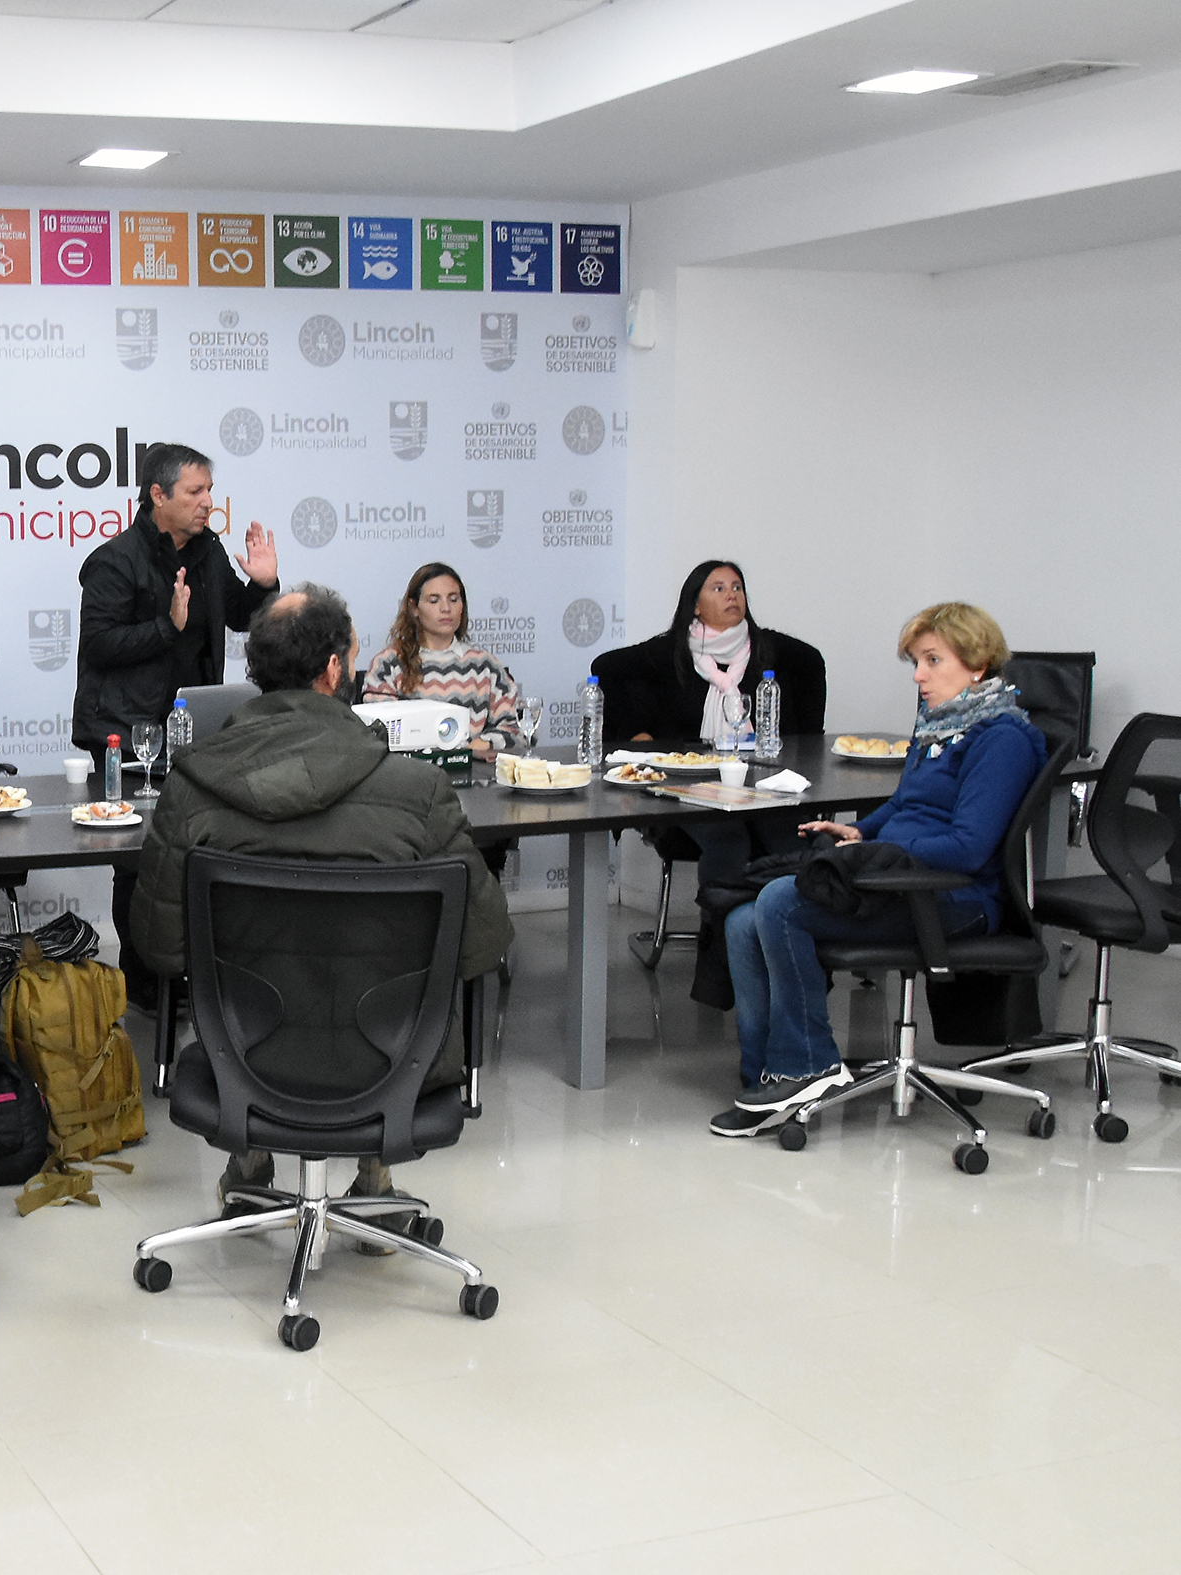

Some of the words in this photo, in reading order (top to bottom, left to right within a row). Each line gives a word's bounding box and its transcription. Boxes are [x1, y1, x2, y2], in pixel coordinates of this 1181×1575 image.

[42, 214, 57, 233] 10
[124, 216, 135, 234] 11
[202, 218, 214, 235] 12
[277, 219, 290, 237] 13
[352, 222, 364, 239] 14
[425, 223, 437, 240] 15
[495, 226, 508, 243] 16
[565, 228, 576, 245] 17
[189, 331, 269, 347] OBJETIVOS
[353, 321, 435, 344] Lincoln
[545, 334, 617, 350] OBJETIVOS
[189, 348, 203, 358] DE
[205, 348, 269, 358] DESARROLLO
[353, 345, 453, 362] Municipalidad
[546, 350, 557, 360] DE
[559, 350, 617, 361] DESARROLLO
[190, 358, 269, 371] SOSTENIBLE
[546, 360, 617, 374] SOSTENIBLE
[271, 412, 349, 434] Lincoln
[464, 422, 537, 437] OBJETIVOS
[271, 435, 367, 451] Municipalidad
[465, 437, 477, 448] DE
[479, 437, 537, 448] DESARROLLO
[465, 447, 537, 461] SOSTENIBLE
[344, 502, 426, 523] Lincoln
[542, 509, 613, 524] OBJETIVOS
[344, 525, 445, 542] Municipalidad
[543, 525, 554, 534] DE
[556, 525, 613, 535] DESARROLLO
[543, 534, 613, 547] SOSTENIBLE
[478, 633, 535, 642] DESARROLLO
[470, 642, 535, 655] OSTENIBLE
